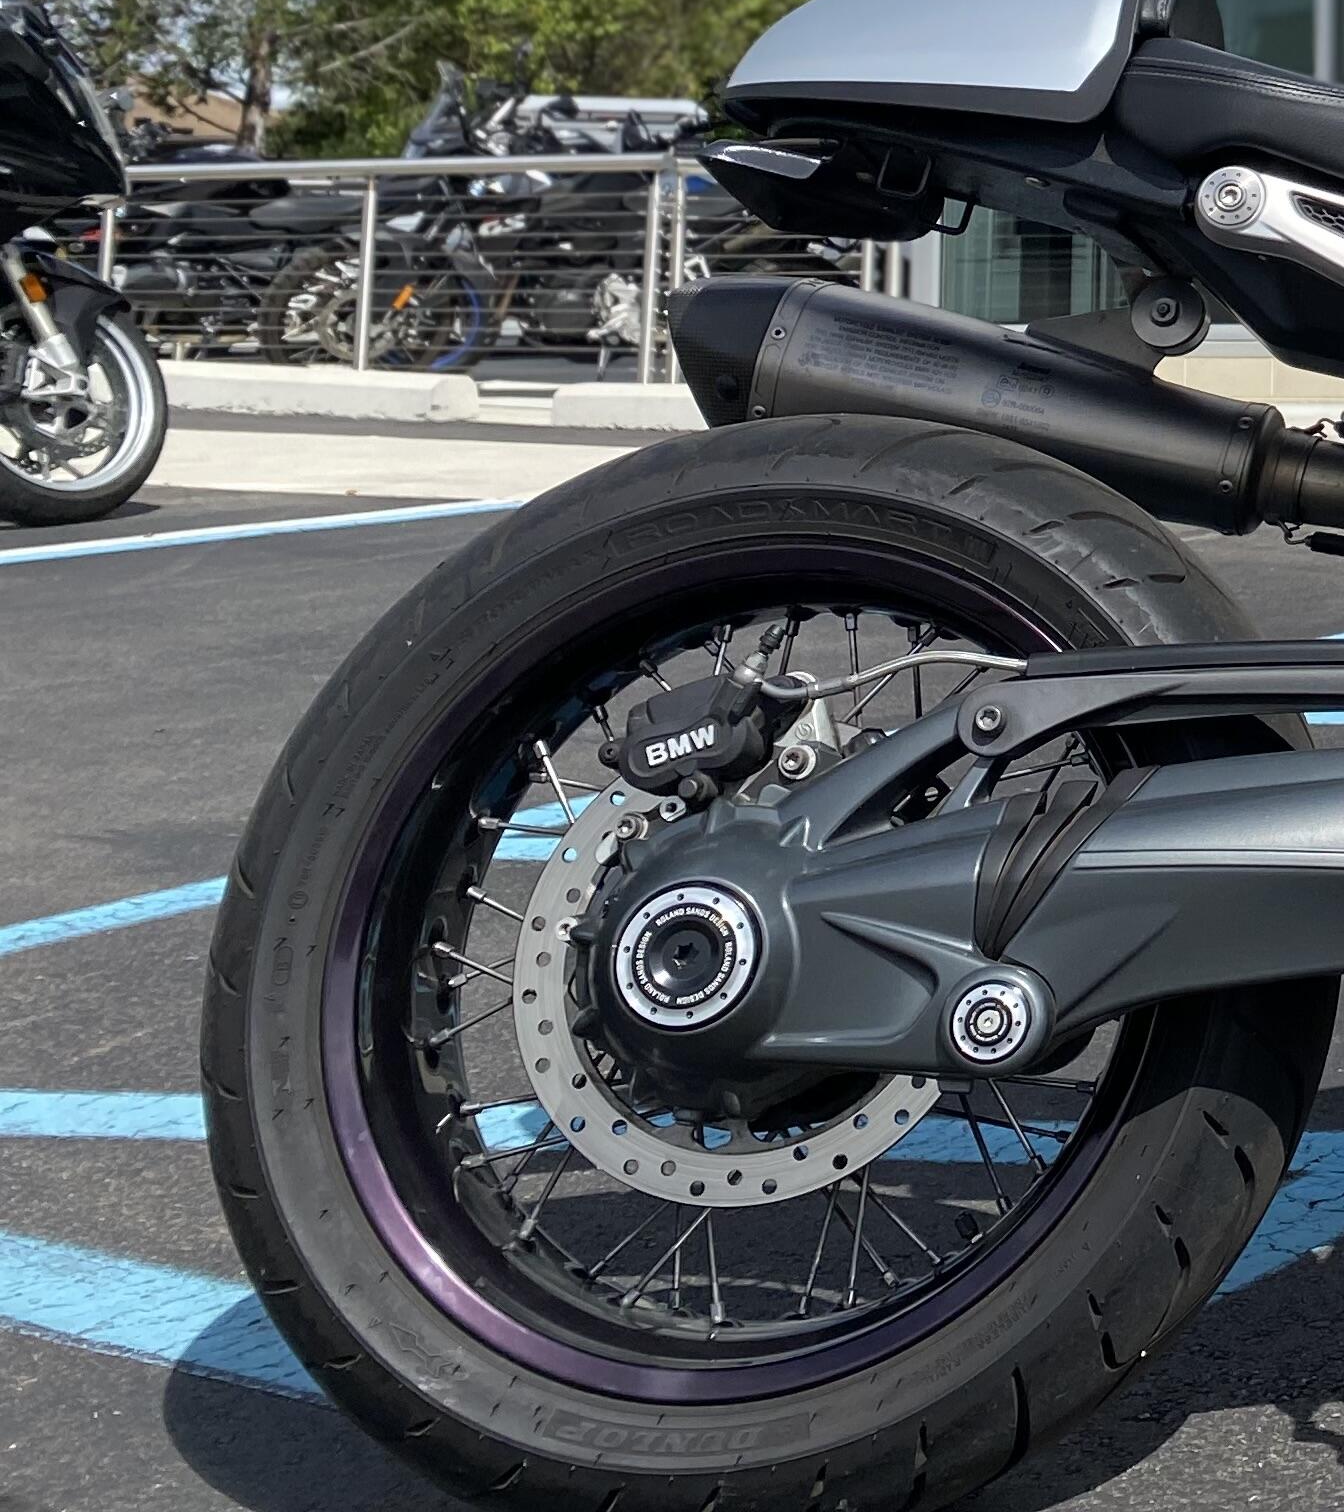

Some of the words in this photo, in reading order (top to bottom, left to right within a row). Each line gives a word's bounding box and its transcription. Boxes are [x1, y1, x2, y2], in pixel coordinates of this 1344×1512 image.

[645, 724, 716, 767] BMW
[655, 907, 686, 927] ROLAND
[685, 906, 710, 919] SANDS
[709, 911, 731, 938] DESIGN
[635, 930, 653, 960] DESIGN
[720, 941, 734, 974] ROLAND
[635, 959, 648, 986] SANDS
[705, 972, 727, 997] SANDS
[644, 983, 671, 1005] ROLAND
[676, 991, 706, 1006] DESIGN
[555, 1421, 763, 1455] DUNLOP
